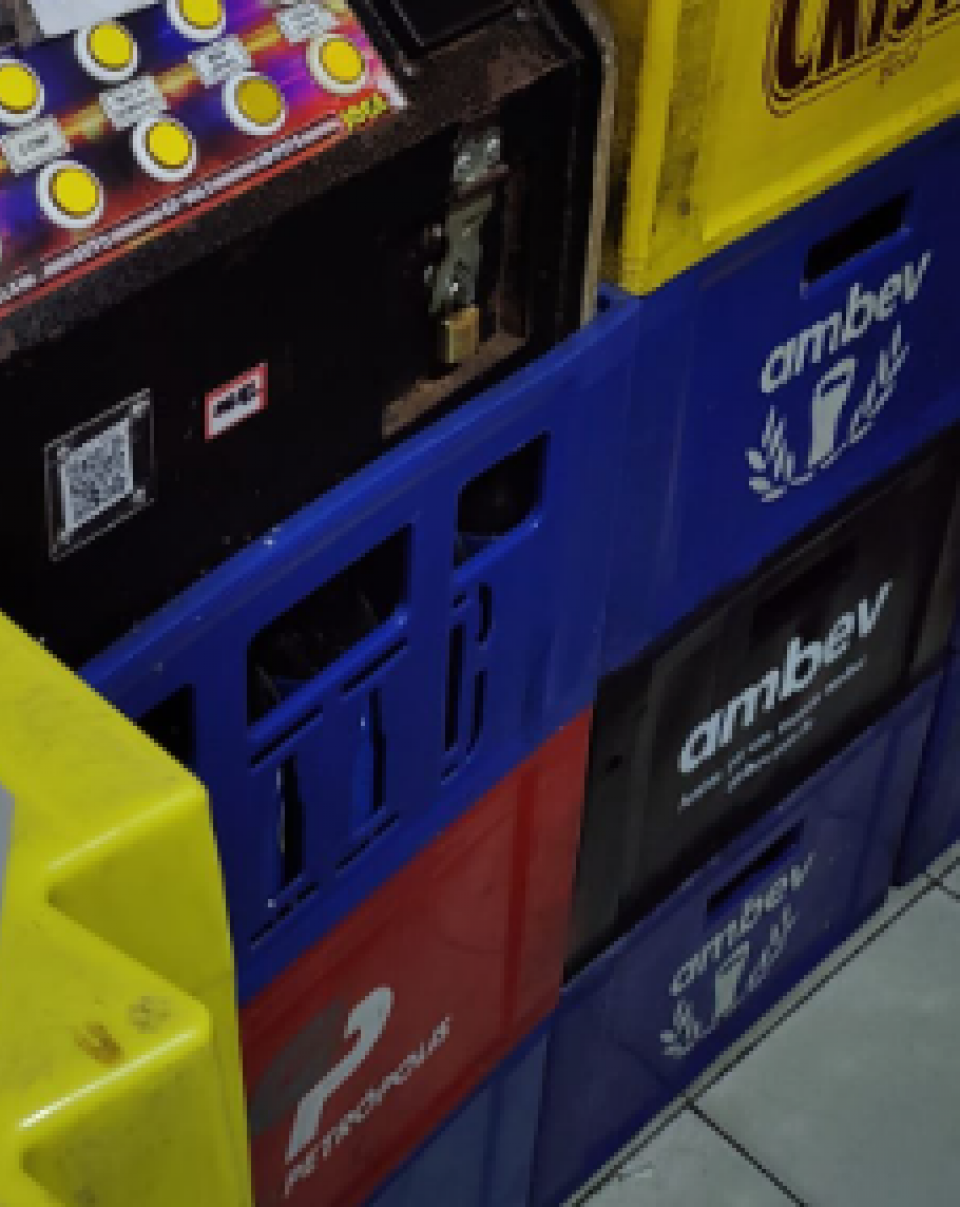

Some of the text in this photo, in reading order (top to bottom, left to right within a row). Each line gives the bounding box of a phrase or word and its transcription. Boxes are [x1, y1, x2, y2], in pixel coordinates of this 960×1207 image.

[760, 248, 932, 395] ambev
[677, 577, 893, 774] ambev
[669, 849, 817, 998] ambev
